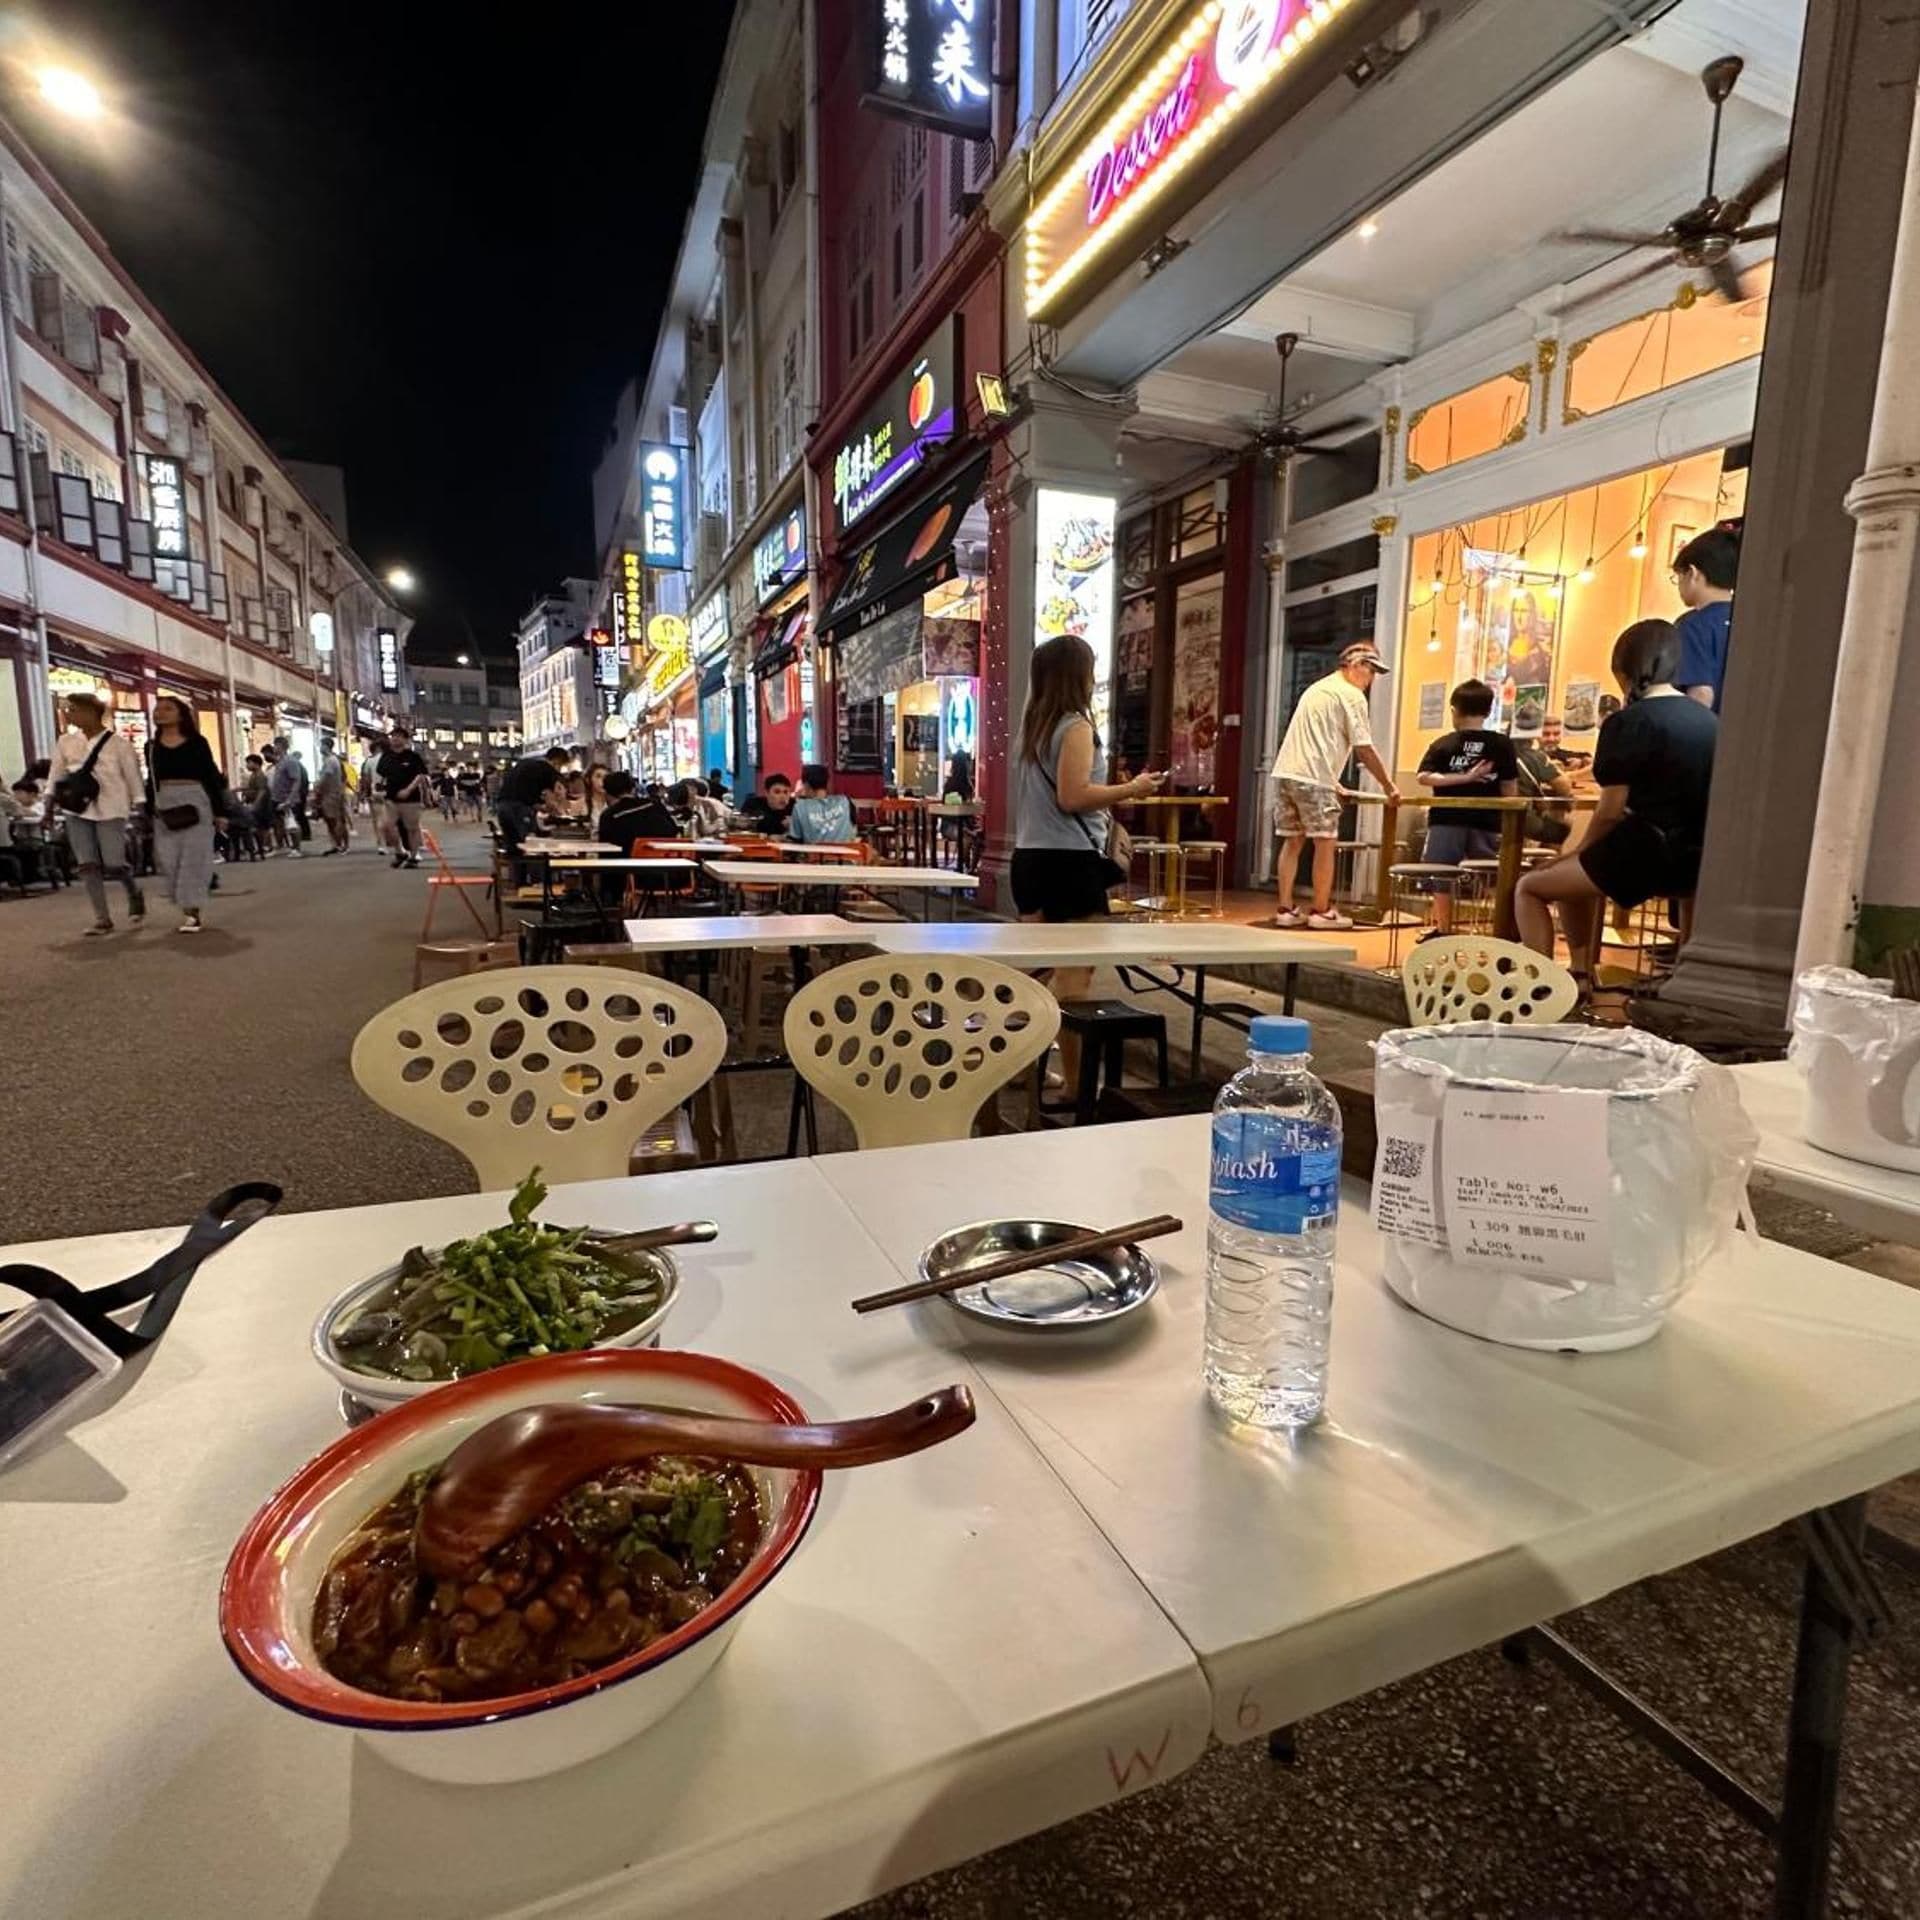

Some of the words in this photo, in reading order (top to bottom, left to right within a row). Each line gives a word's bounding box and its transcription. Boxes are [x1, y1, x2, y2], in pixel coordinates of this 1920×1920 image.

[1087, 55, 1200, 224] Dessert
[1457, 1175, 1499, 1190] Table
[1106, 1726, 1171, 1793] W
[1236, 1683, 1262, 1731] 6
